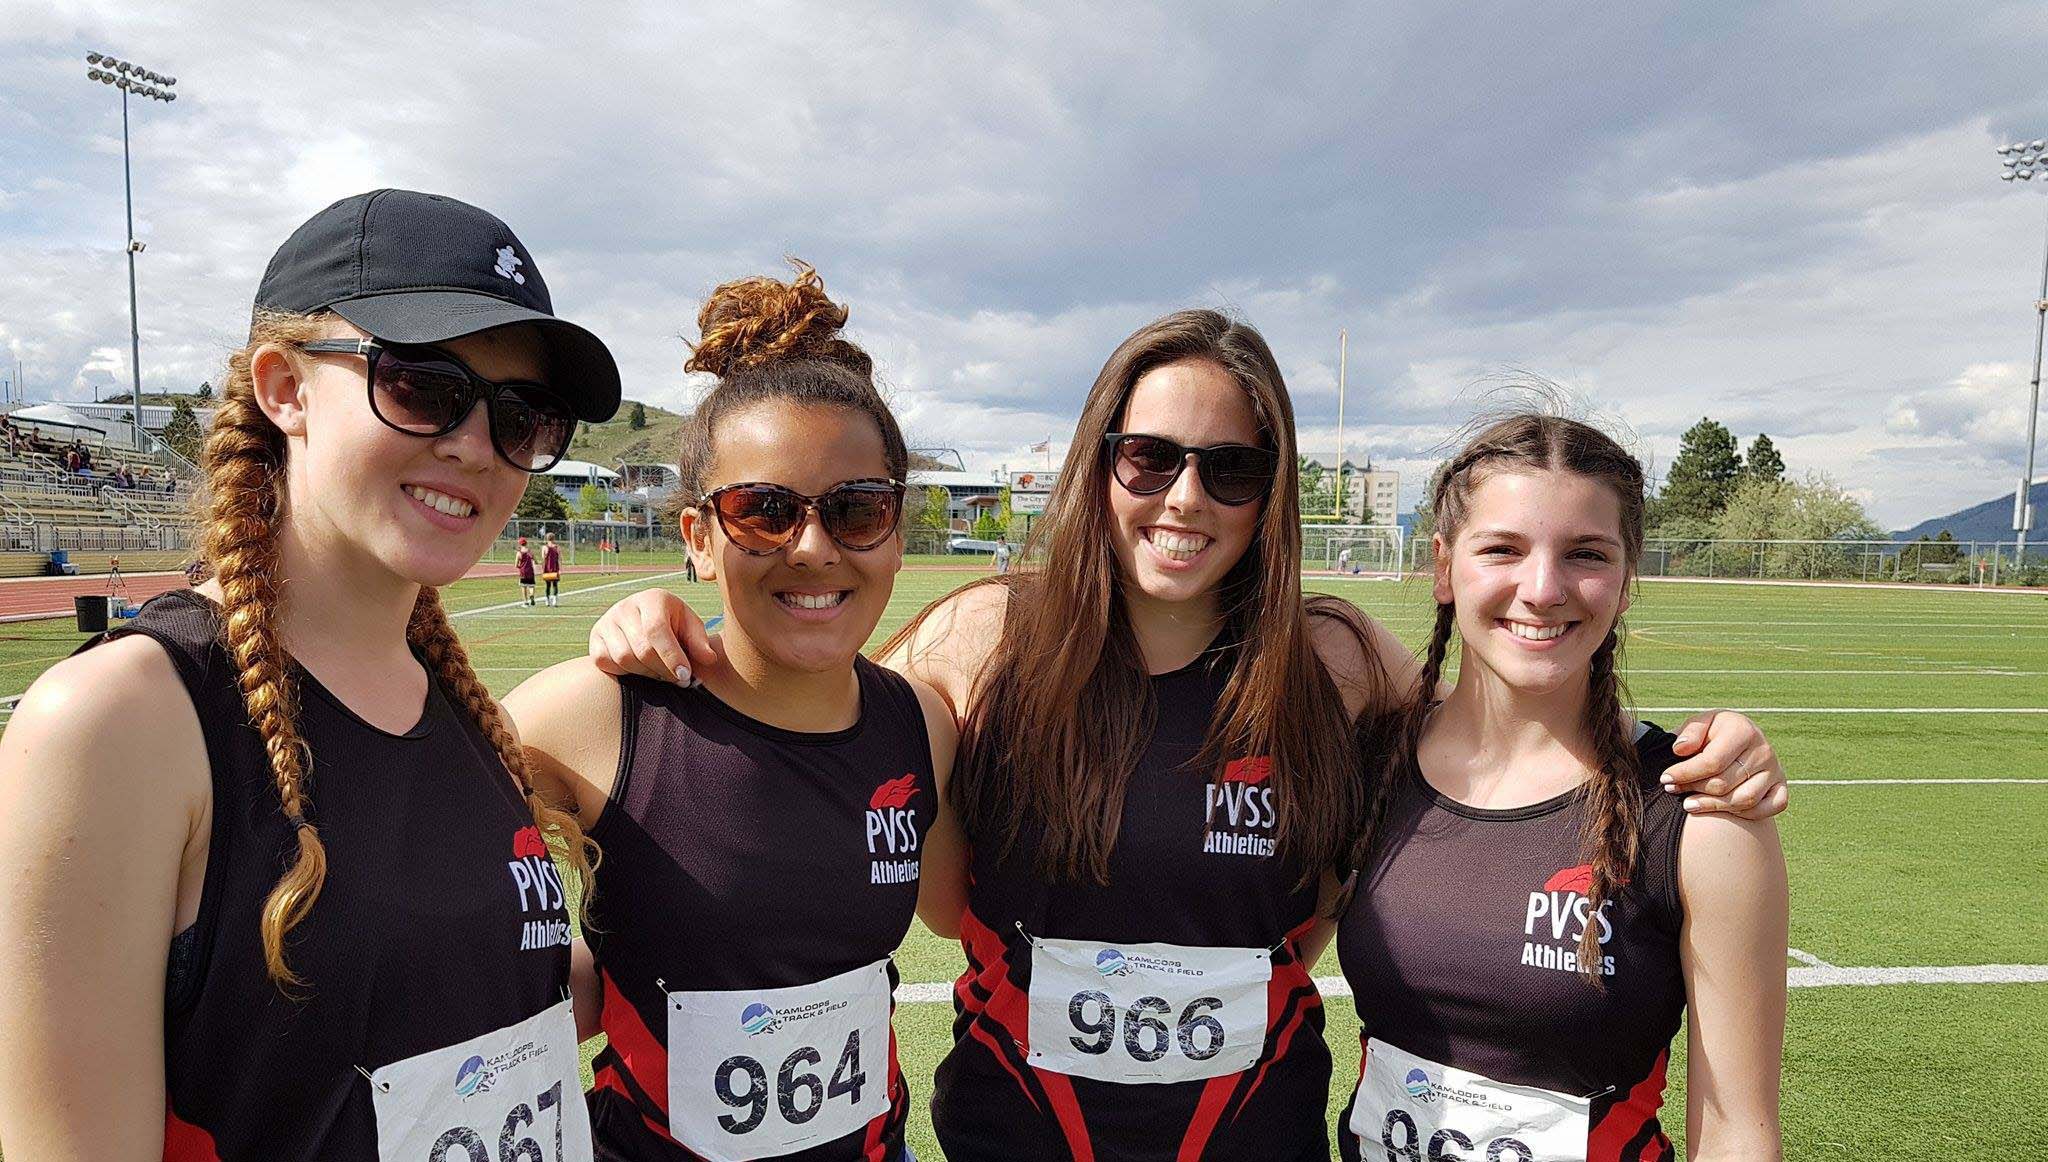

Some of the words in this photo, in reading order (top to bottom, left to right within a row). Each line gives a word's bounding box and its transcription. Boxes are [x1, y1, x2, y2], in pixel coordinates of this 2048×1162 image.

[1206, 782, 1276, 828] PVSS
[866, 807, 917, 854] PVSS
[1203, 831, 1275, 857] Athletics
[871, 859, 919, 884] Athletics
[1525, 891, 1613, 944] PVSS
[1134, 963, 1165, 973] TRACK
[1176, 968, 1204, 976] FIELD
[1521, 942, 1615, 976] Athlecs
[775, 1000, 830, 1015] KAMLOOPS
[782, 1011, 816, 1022] TRACK
[826, 1001, 848, 1013] FIELD
[1068, 989, 1225, 1062] 966
[494, 1056, 521, 1073] TRACK
[714, 1028, 866, 1135] 964
[1431, 1082, 1487, 1101] KAMLOOPS
[1436, 1091, 1470, 1105] TRACK
